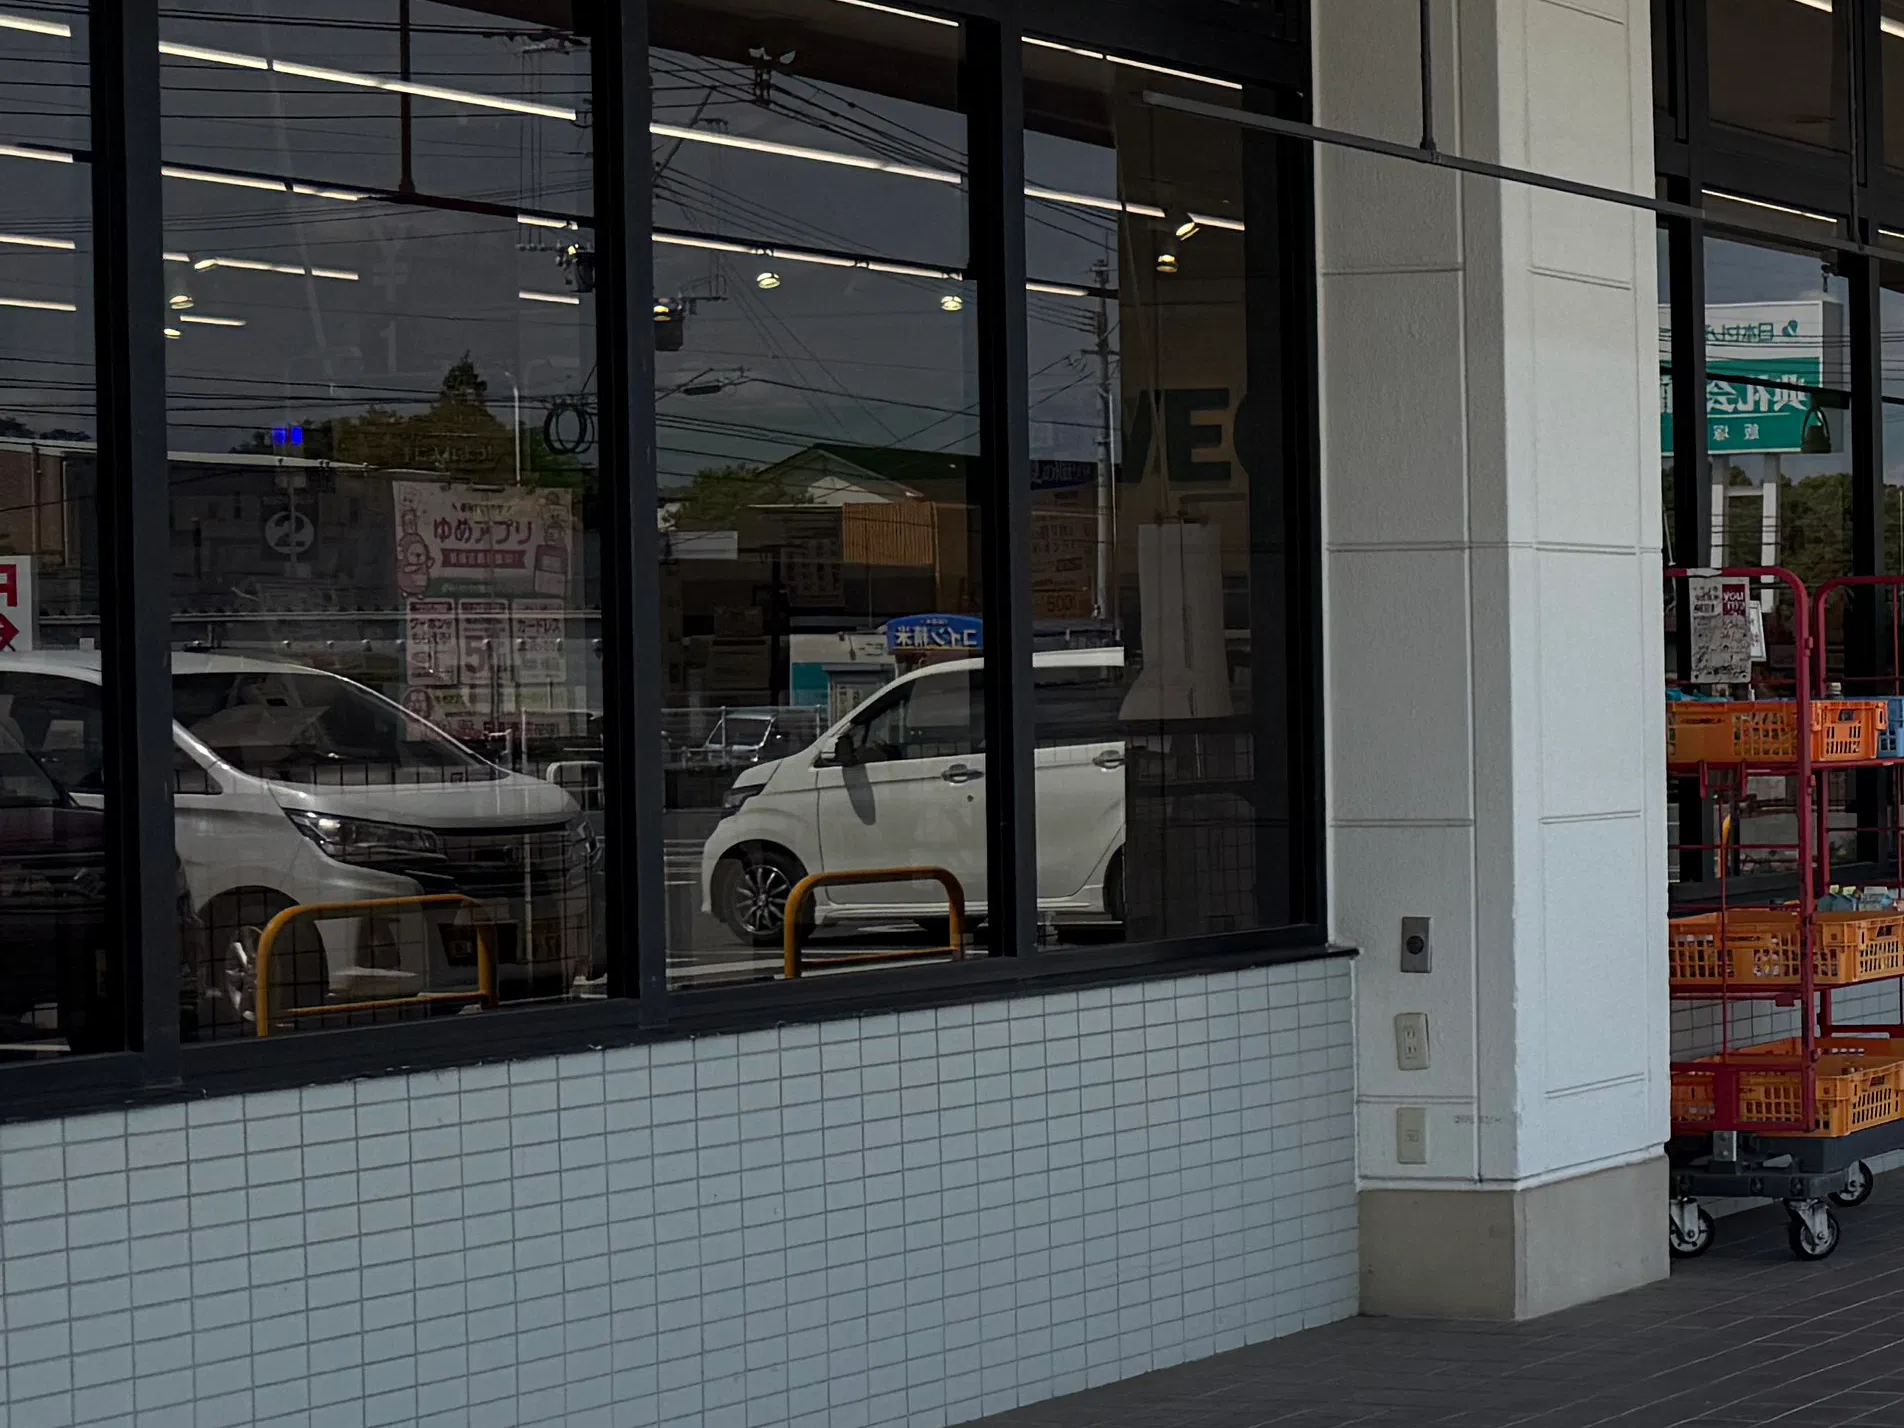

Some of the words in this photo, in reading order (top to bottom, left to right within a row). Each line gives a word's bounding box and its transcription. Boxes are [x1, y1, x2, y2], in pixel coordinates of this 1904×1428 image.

[433, 516, 532, 544] ゆめアプリ
[1723, 590, 1744, 602] you
